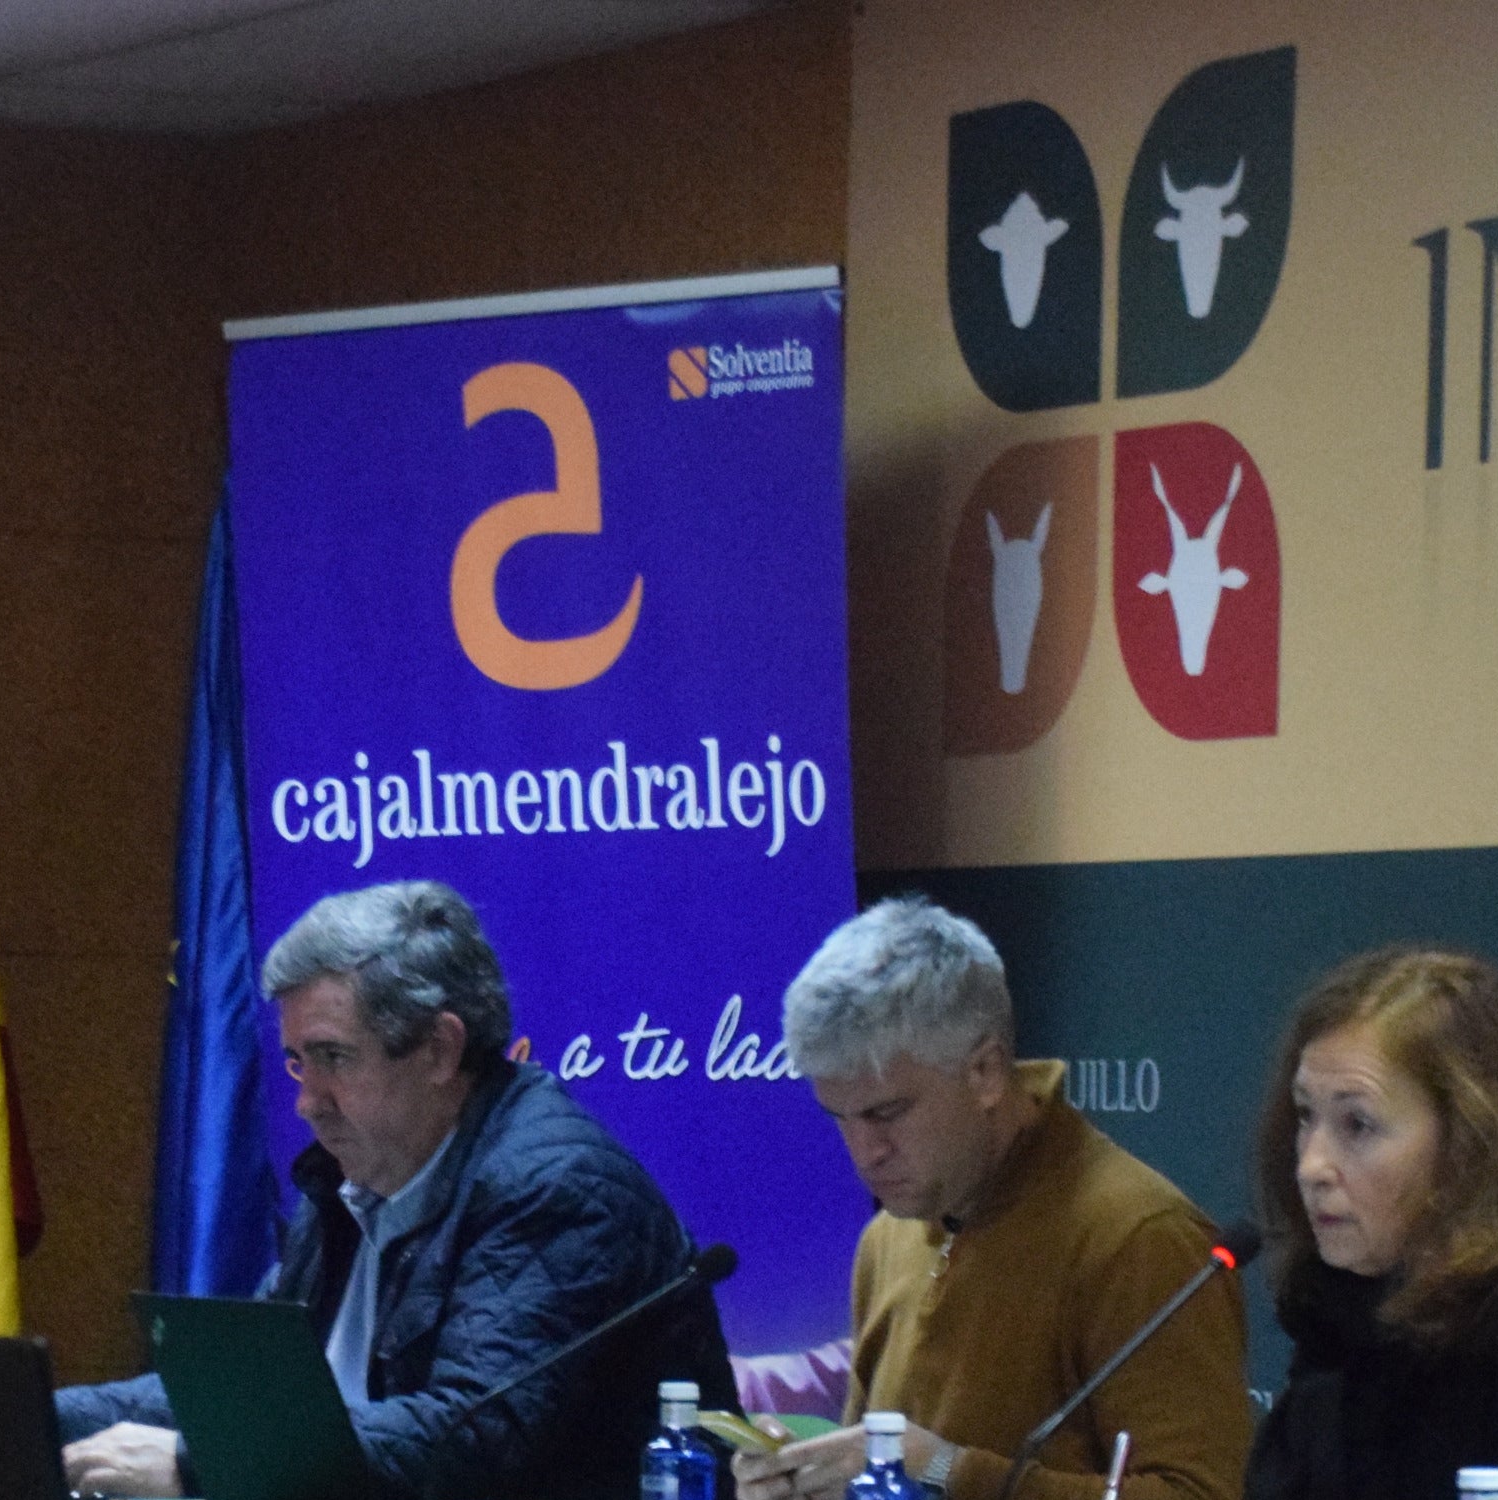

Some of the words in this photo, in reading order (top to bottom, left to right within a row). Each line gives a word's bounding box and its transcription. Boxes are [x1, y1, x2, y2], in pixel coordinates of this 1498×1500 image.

[708, 338, 814, 379] Solventia
[270, 735, 828, 868] cajalmendralejo
[559, 1034, 605, 1081] a
[617, 1012, 689, 1080] tu
[705, 994, 803, 1081] lad
